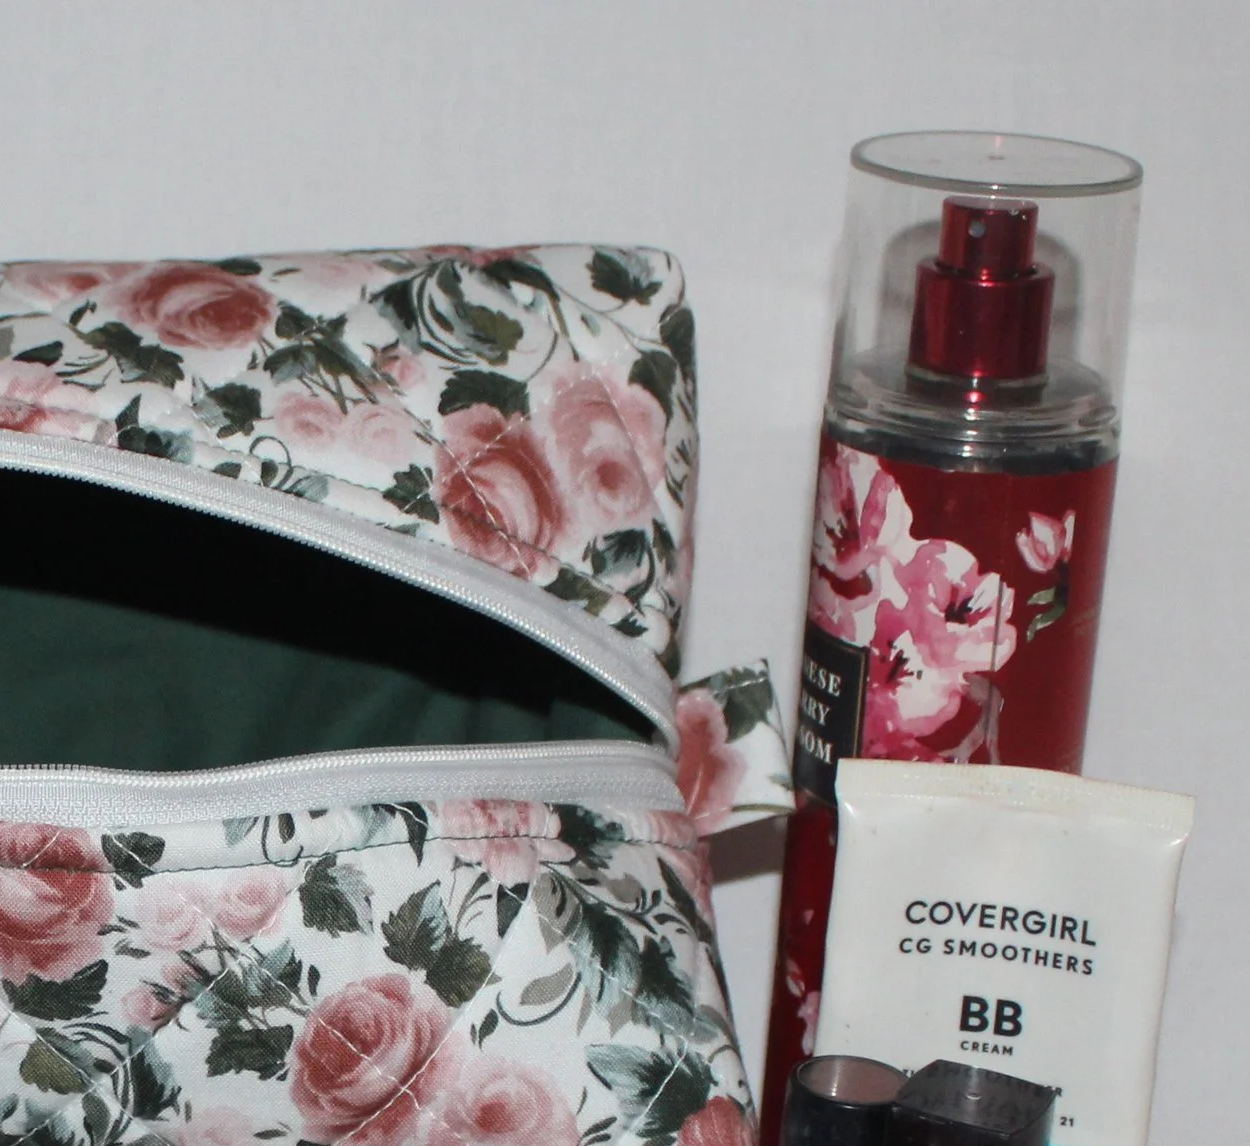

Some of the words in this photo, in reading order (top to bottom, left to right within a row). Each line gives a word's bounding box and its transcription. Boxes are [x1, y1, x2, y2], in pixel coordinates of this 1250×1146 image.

[905, 900, 1097, 946] COVERGIRL
[899, 937, 932, 954] CG
[943, 938, 1093, 975] SMOOTHERS
[959, 995, 1023, 1037] BB
[960, 1040, 1014, 1056] CREAM
[1060, 1117, 1074, 1127] 21
